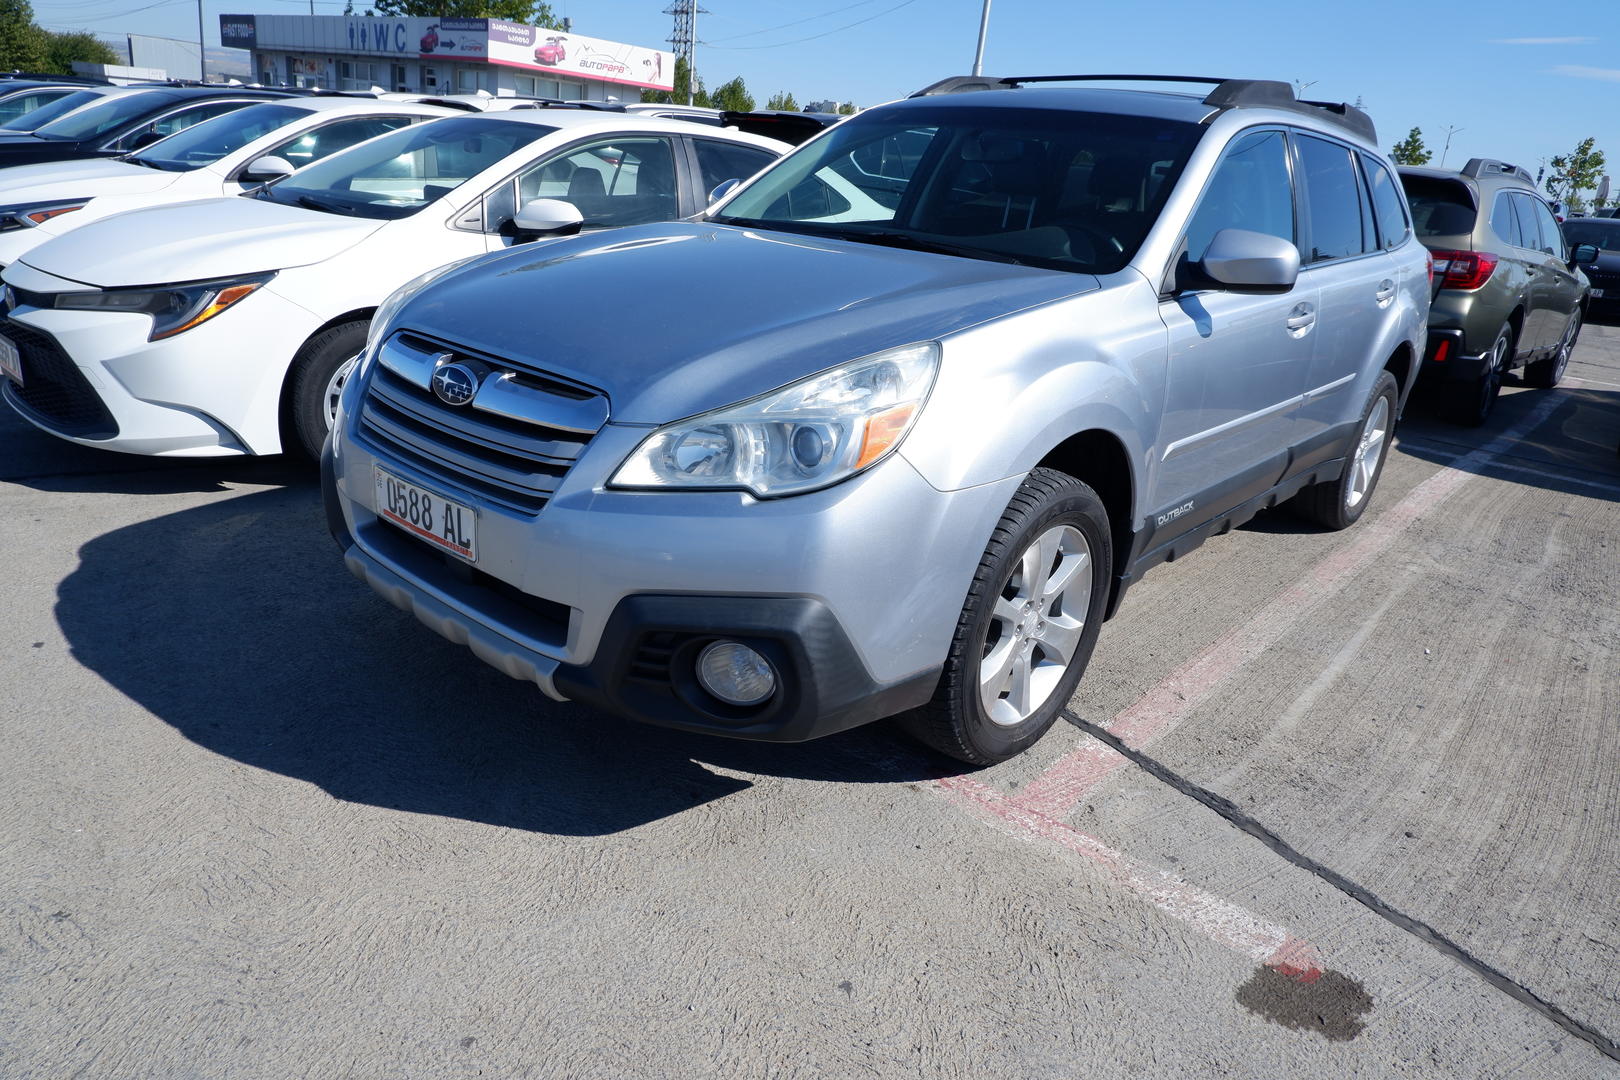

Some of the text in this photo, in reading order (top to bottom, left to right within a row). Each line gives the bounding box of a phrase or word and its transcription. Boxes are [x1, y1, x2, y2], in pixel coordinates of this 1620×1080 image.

[374, 23, 405, 53] WC
[387, 477, 471, 549] 0588 AL
[1157, 500, 1194, 525] OUTBACK
